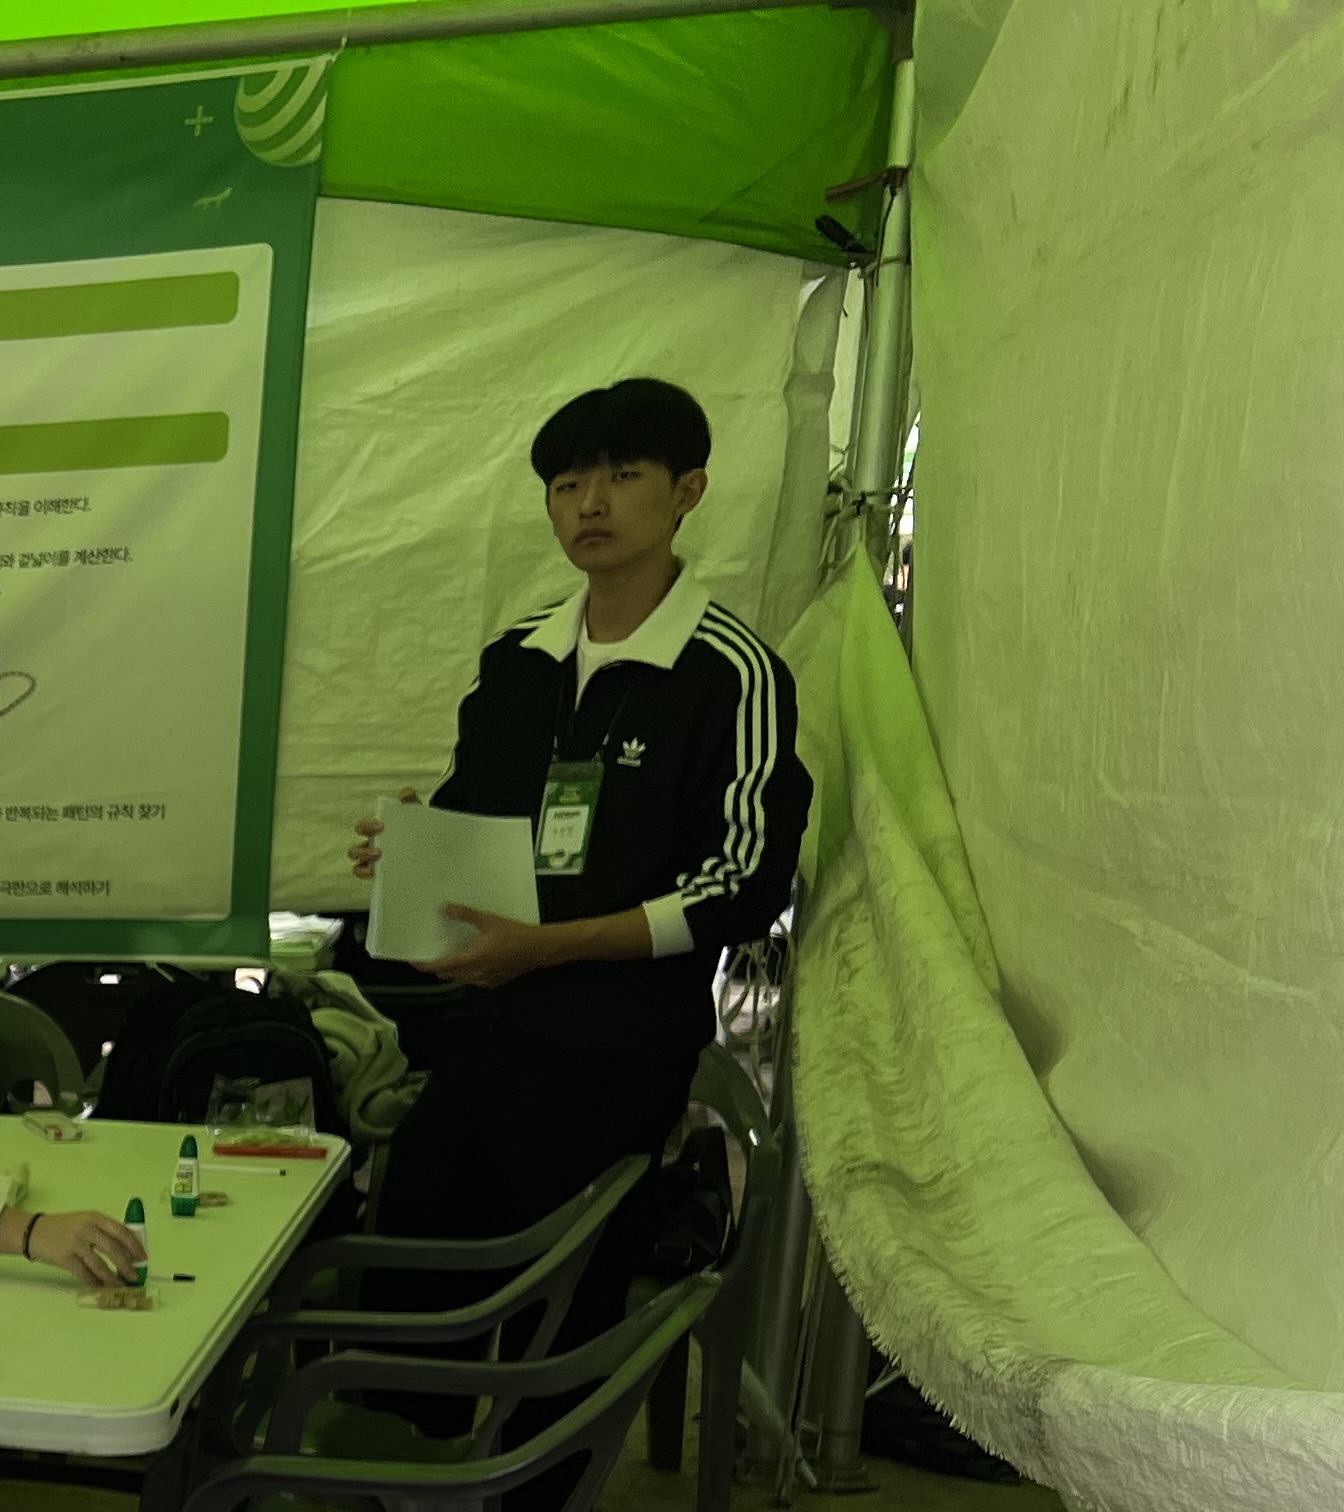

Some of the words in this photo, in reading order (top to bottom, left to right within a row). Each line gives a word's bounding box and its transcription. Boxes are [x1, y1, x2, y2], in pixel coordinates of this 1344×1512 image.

[33, 497, 92, 515] 이해한다.
[73, 546, 133, 565] 계산한다.
[5, 805, 59, 822] 반복되는
[62, 804, 103, 821] 패턴의
[107, 804, 133, 820] 규칙
[138, 803, 165, 820] 찾기
